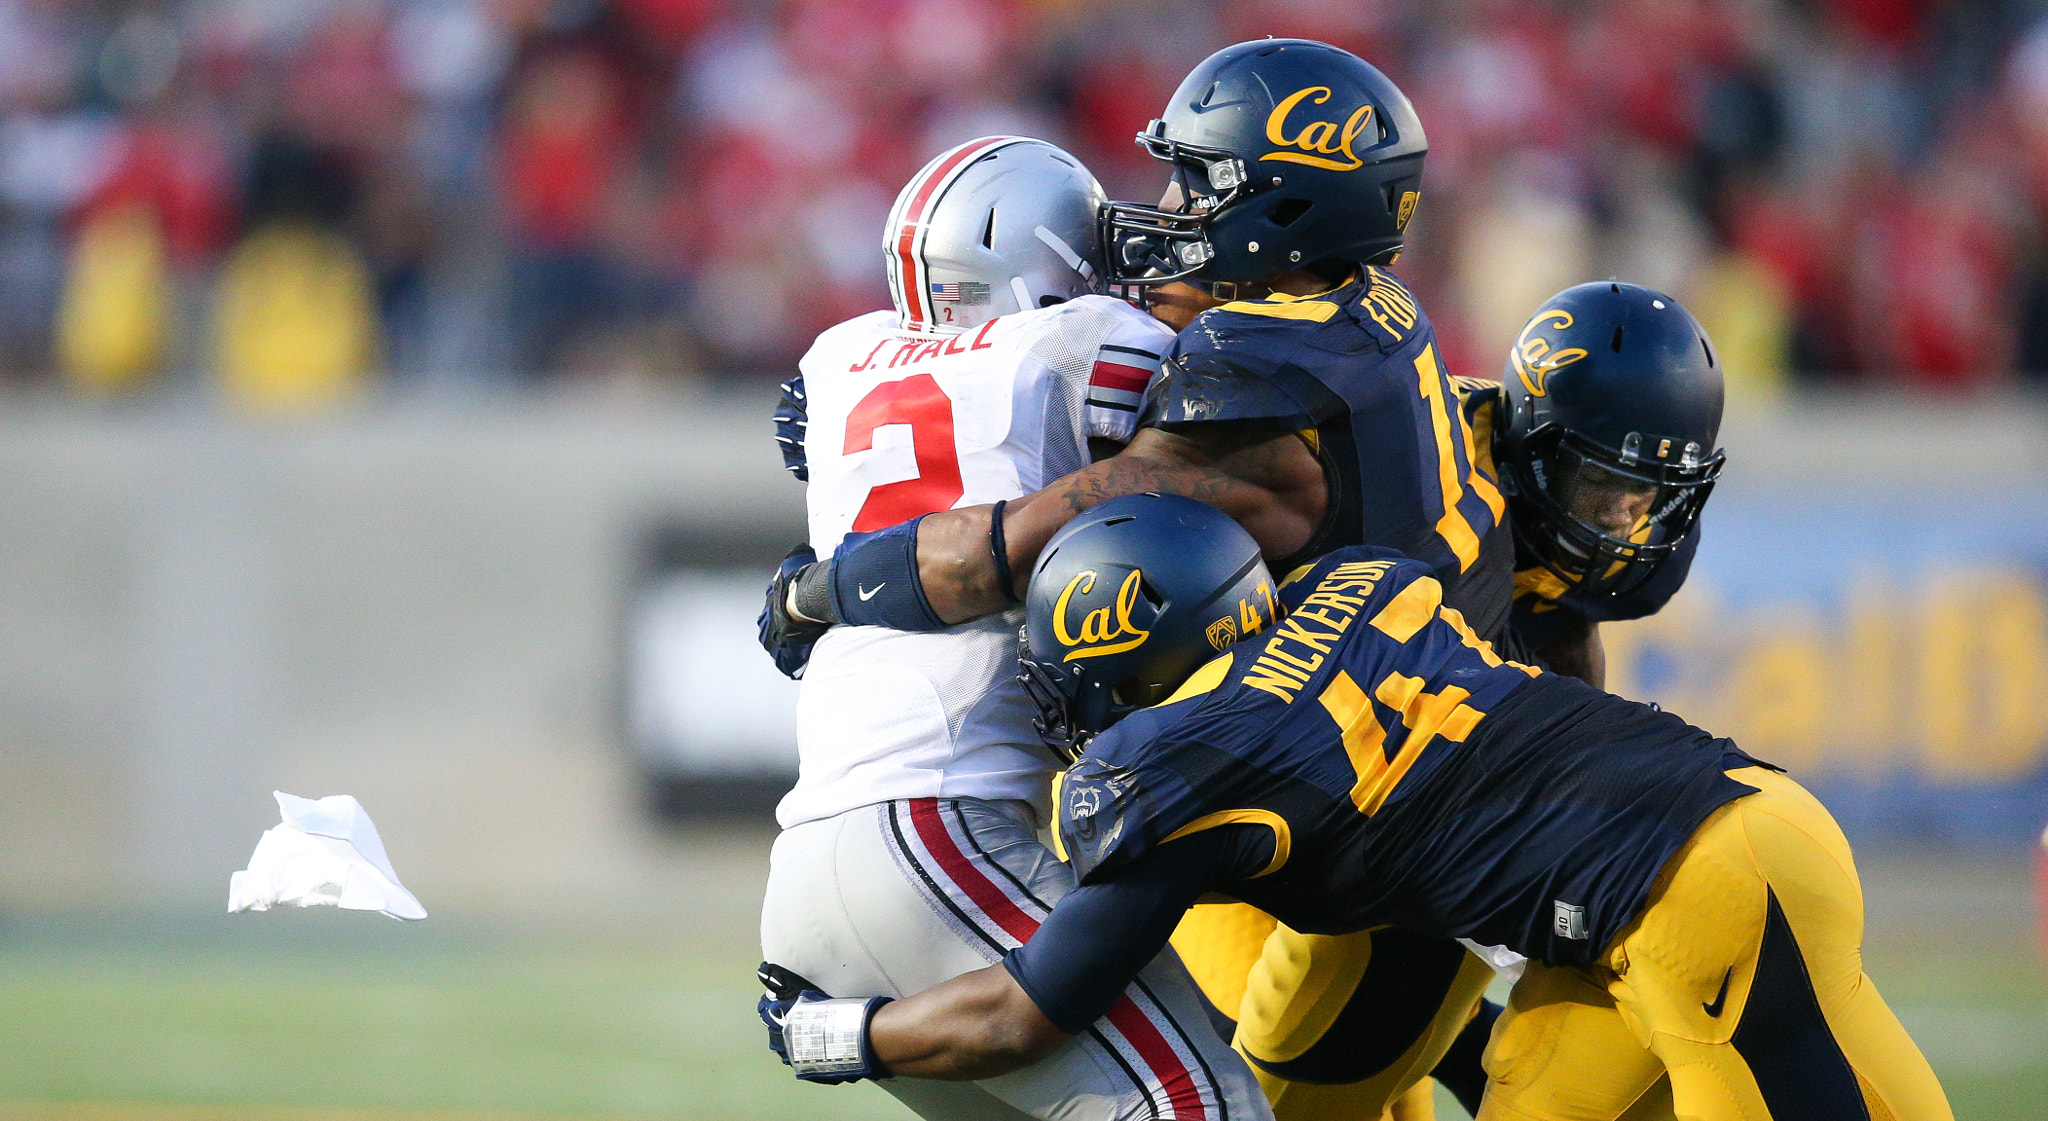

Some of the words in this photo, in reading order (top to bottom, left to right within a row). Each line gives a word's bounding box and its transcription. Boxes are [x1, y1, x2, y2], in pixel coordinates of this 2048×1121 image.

[1258, 86, 1373, 172] Cal
[888, 317, 1000, 369] HALL
[944, 307, 954, 322] 2
[1510, 309, 1588, 398] Cal
[842, 373, 965, 532] 2
[1052, 568, 1150, 664] Cal
[1207, 618, 1236, 646] PAC
[1239, 580, 1277, 635] 47
[1241, 560, 1398, 704] NICKERSON
[1317, 575, 1545, 818] 47
[1558, 916, 1569, 931] 40
